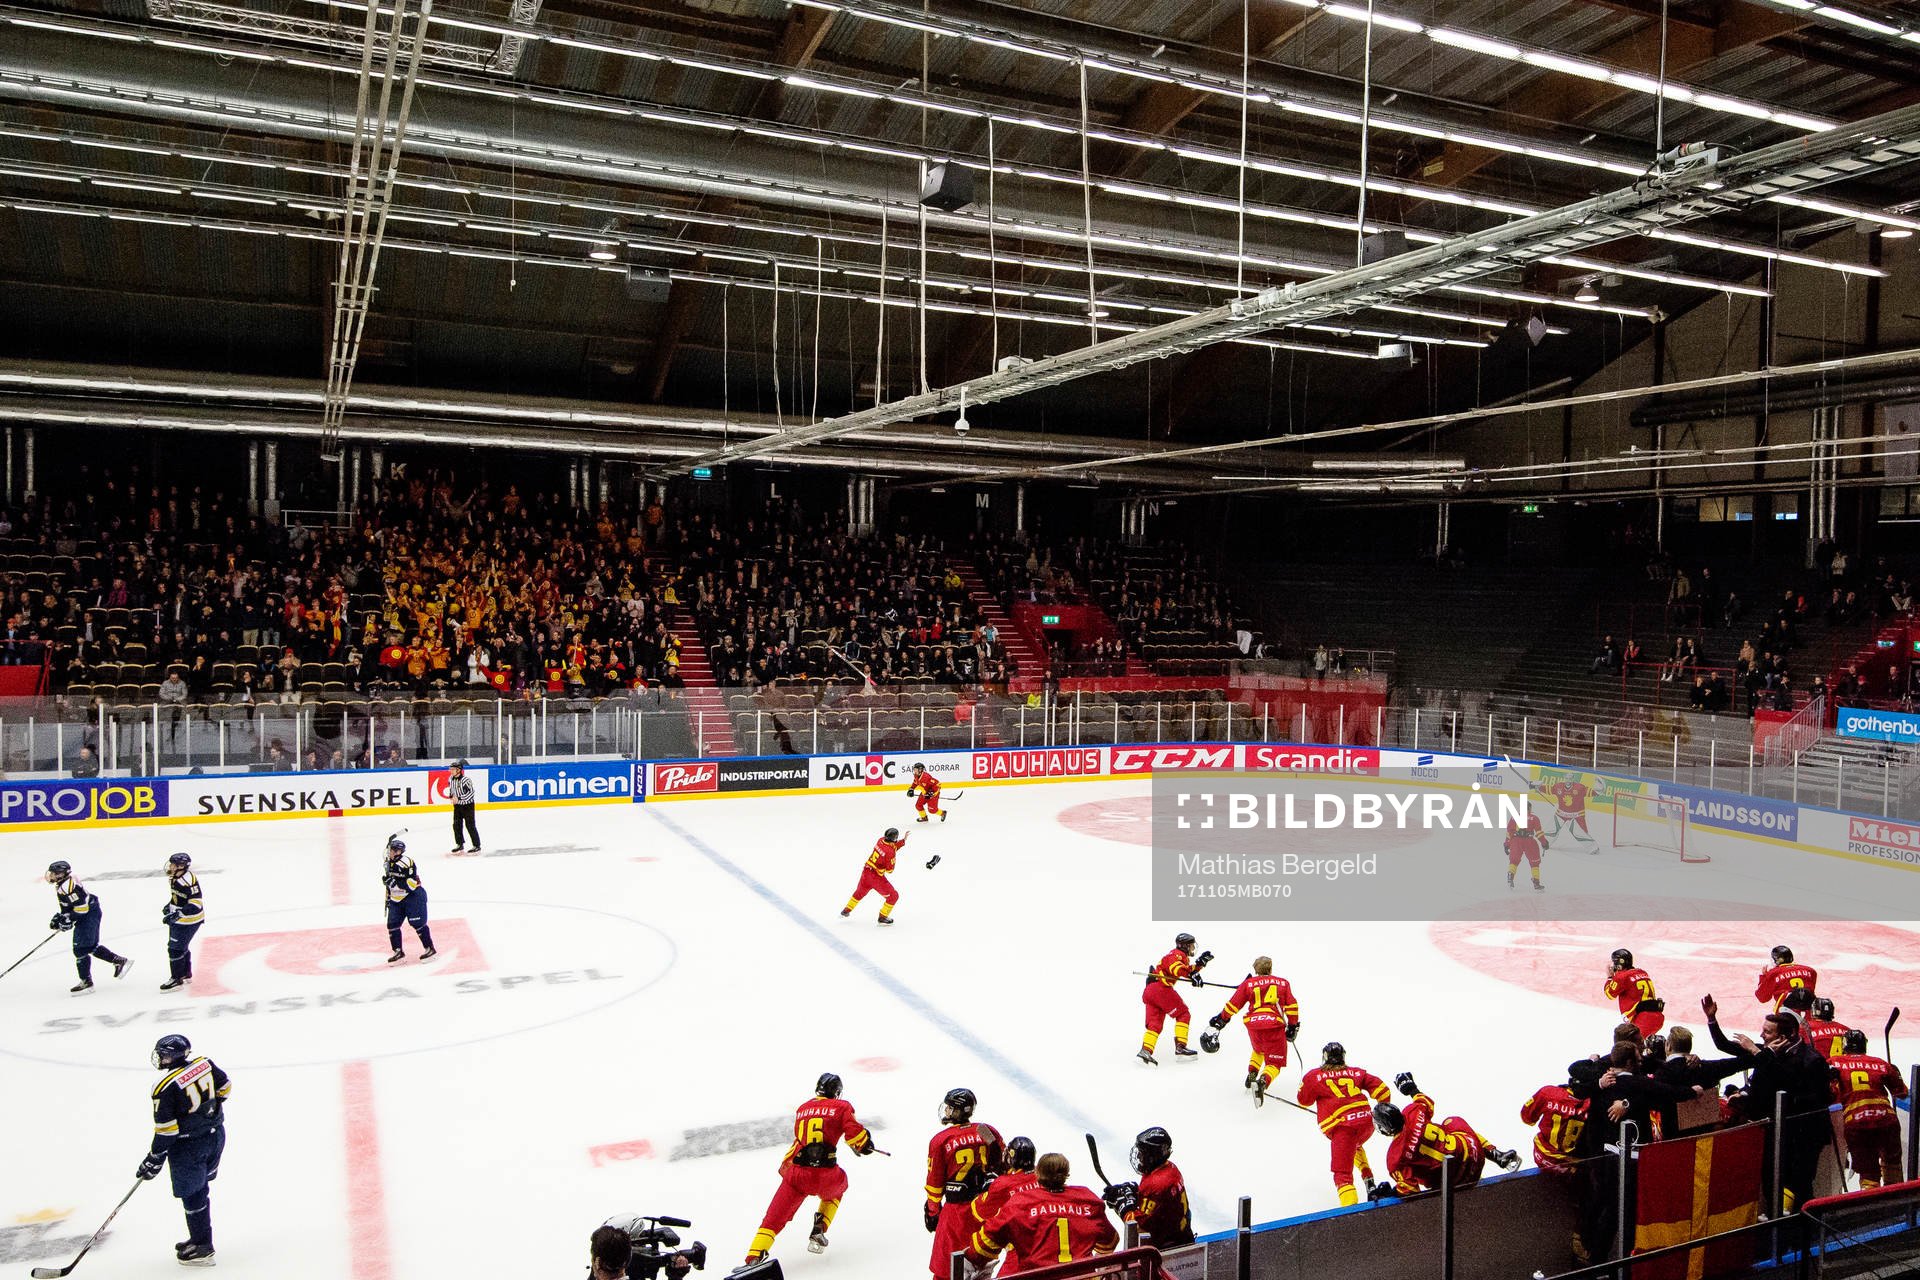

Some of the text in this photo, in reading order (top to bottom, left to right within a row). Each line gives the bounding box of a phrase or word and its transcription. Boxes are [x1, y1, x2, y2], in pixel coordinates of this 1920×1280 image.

[391, 462, 407, 480] K
[770, 483, 781, 499] L
[975, 493, 989, 508] M
[1149, 502, 1160, 517] N
[975, 751, 1098, 775] BAUHAUS
[1113, 748, 1232, 770] CCM
[1256, 747, 1368, 775] Scandic
[659, 766, 713, 791] Prido
[720, 769, 808, 782] INDUSTRIPORTAR
[825, 761, 896, 781] DALOC
[1410, 767, 1439, 778] NOCCO
[1476, 773, 1503, 785] NOCCO
[491, 770, 628, 798] onninen
[2, 786, 157, 821] PROJOB
[198, 787, 420, 815] SVENSKA SPEL
[1852, 820, 1920, 848] Miel
[1248, 979, 1287, 988] BAUHAUS
[38, 968, 625, 1035] SVENSKA SPEL
[1253, 985, 1279, 1009] 14
[1316, 1070, 1361, 1081] BAUHAUS
[1834, 1061, 1886, 1072] BAUHAUS
[186, 1072, 216, 1114] 17
[1325, 1077, 1362, 1098] 12
[1854, 1109, 1887, 1120] CCM
[798, 1117, 824, 1146] 16
[1418, 1122, 1457, 1162] 13
[1549, 1113, 1585, 1153] 18
[945, 1134, 983, 1152] BAUHA
[955, 1145, 988, 1182] 21
[1030, 1203, 1092, 1217] BAUHAUS
[1140, 1197, 1157, 1216] 19
[1056, 1217, 1073, 1263] 1
